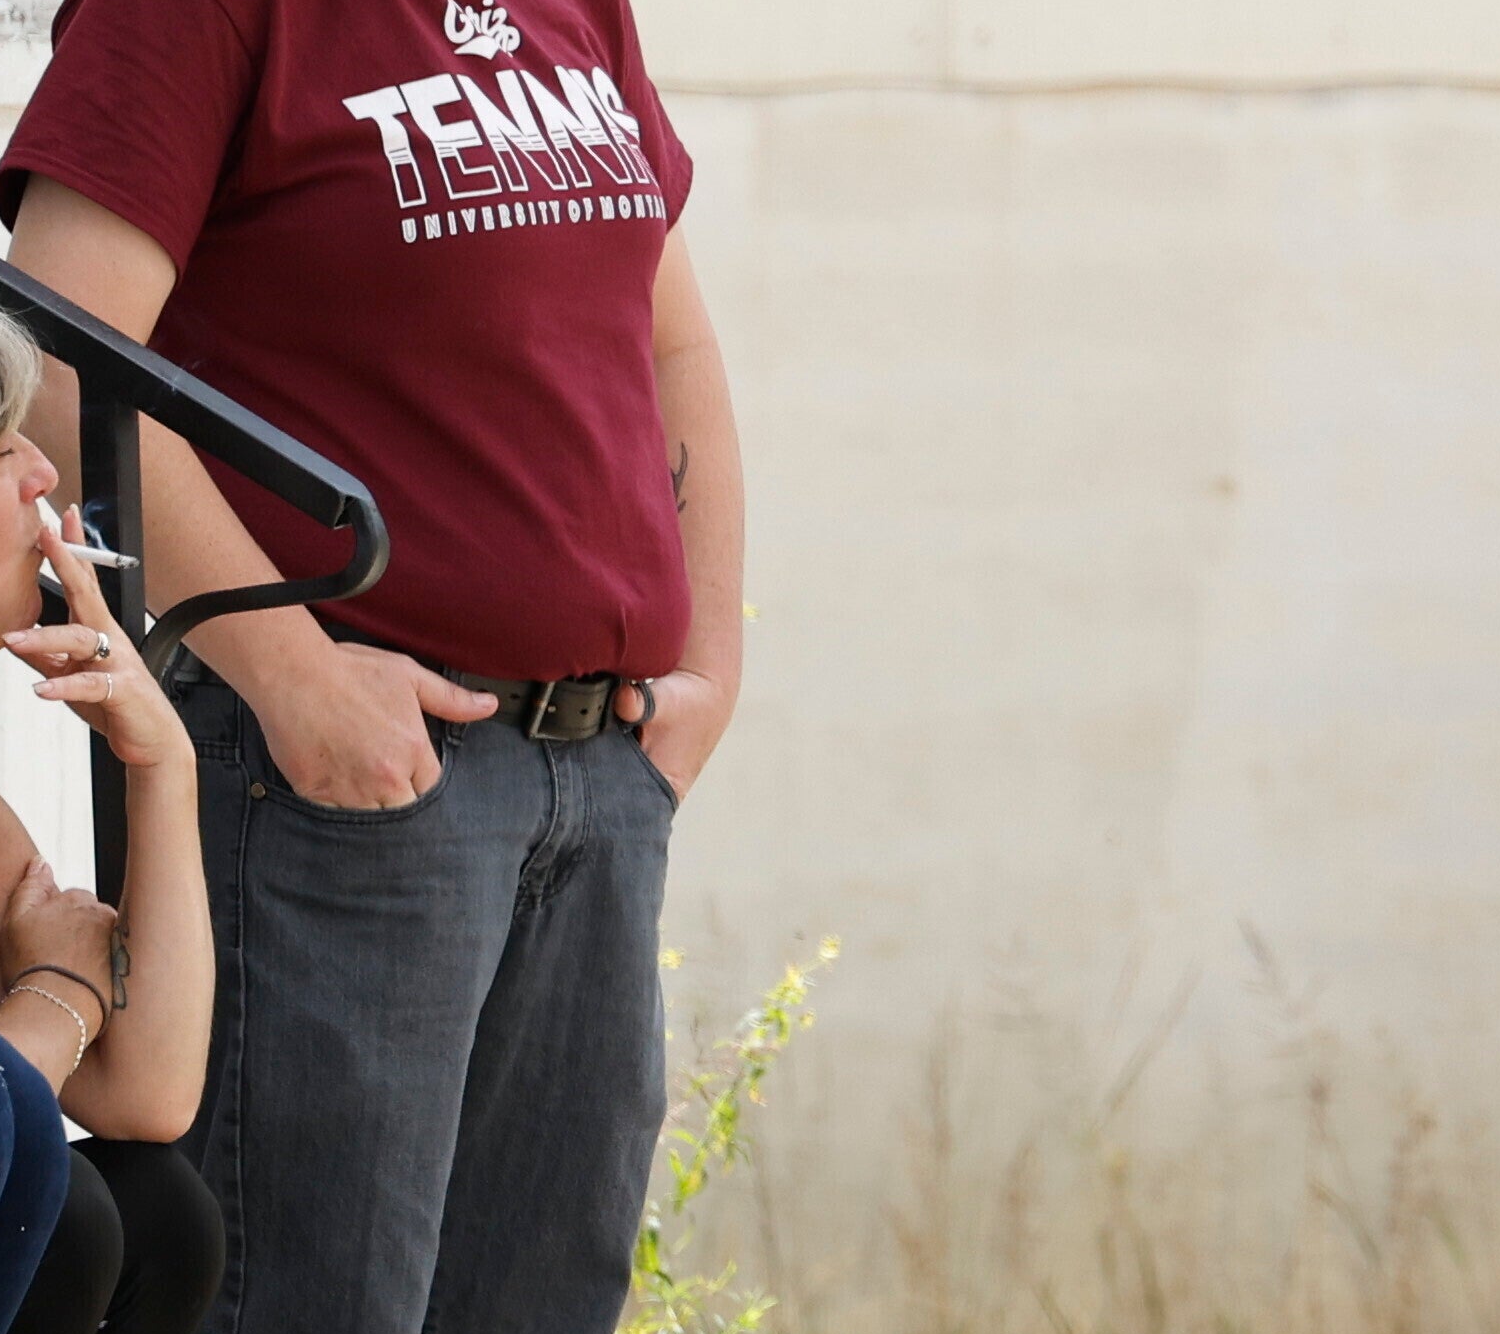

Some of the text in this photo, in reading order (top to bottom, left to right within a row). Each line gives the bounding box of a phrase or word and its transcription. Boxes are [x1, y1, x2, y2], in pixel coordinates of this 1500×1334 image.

[341, 65, 660, 209] TENNIS
[401, 196, 561, 244] UNIVERSITY
[567, 197, 594, 224] OF
